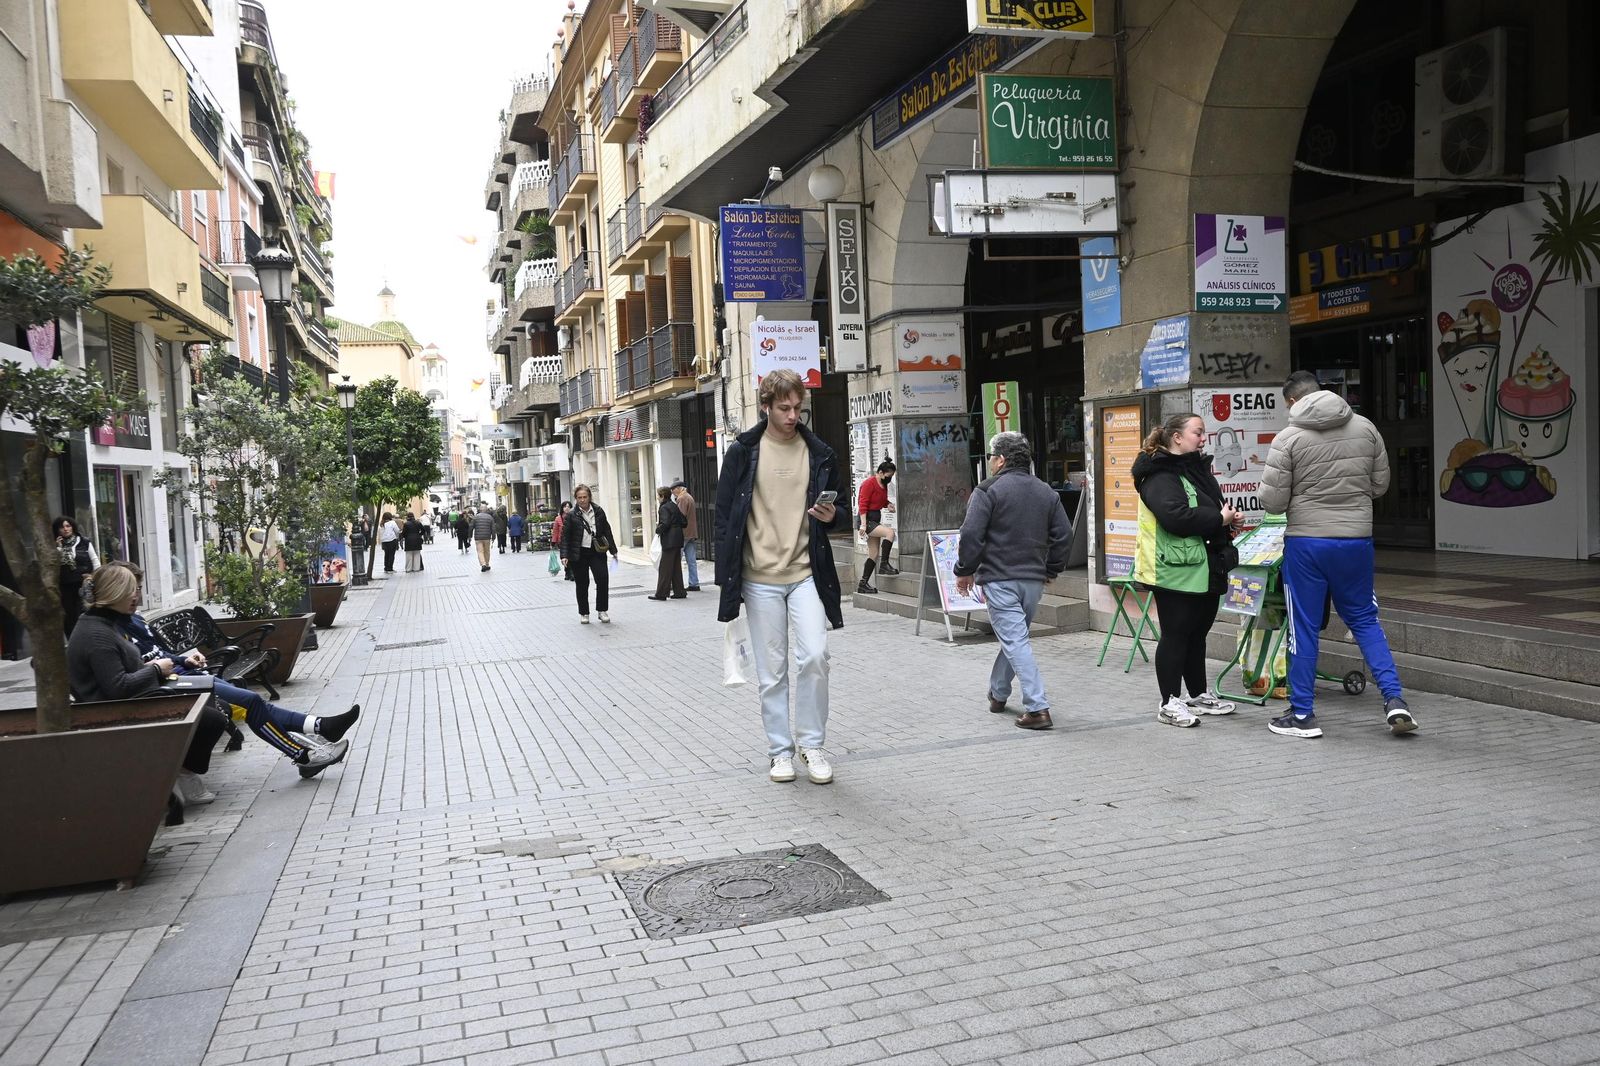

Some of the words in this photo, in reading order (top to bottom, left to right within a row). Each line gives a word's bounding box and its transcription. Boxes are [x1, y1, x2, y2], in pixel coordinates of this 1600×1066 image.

[1033, 2, 1077, 19] CLUB
[901, 82, 930, 124] Salón
[931, 71, 947, 103] De
[991, 101, 1110, 149] Virginia
[724, 210, 750, 223] Salón
[751, 211, 763, 223] De
[765, 211, 800, 224] Estética
[732, 225, 761, 238] Luisa
[838, 219, 858, 304] SEIKO
[1206, 280, 1240, 290] ANÁLISIS
[1242, 280, 1276, 290] CLÍNICOS
[1327, 290, 1344, 299] TODO
[1333, 295, 1352, 305] COSTE
[1201, 297, 1217, 306] 959
[1218, 297, 1234, 306] 248
[1236, 298, 1251, 306] 923
[757, 324, 786, 333] Nicolás
[795, 325, 816, 333] Israel
[838, 323, 863, 331] JOYERIA
[994, 383, 1011, 432] FOT
[1233, 393, 1275, 410] SEAG
[1114, 412, 1137, 421] ALQUILER
[1220, 482, 1256, 493] NTIZAMOS
